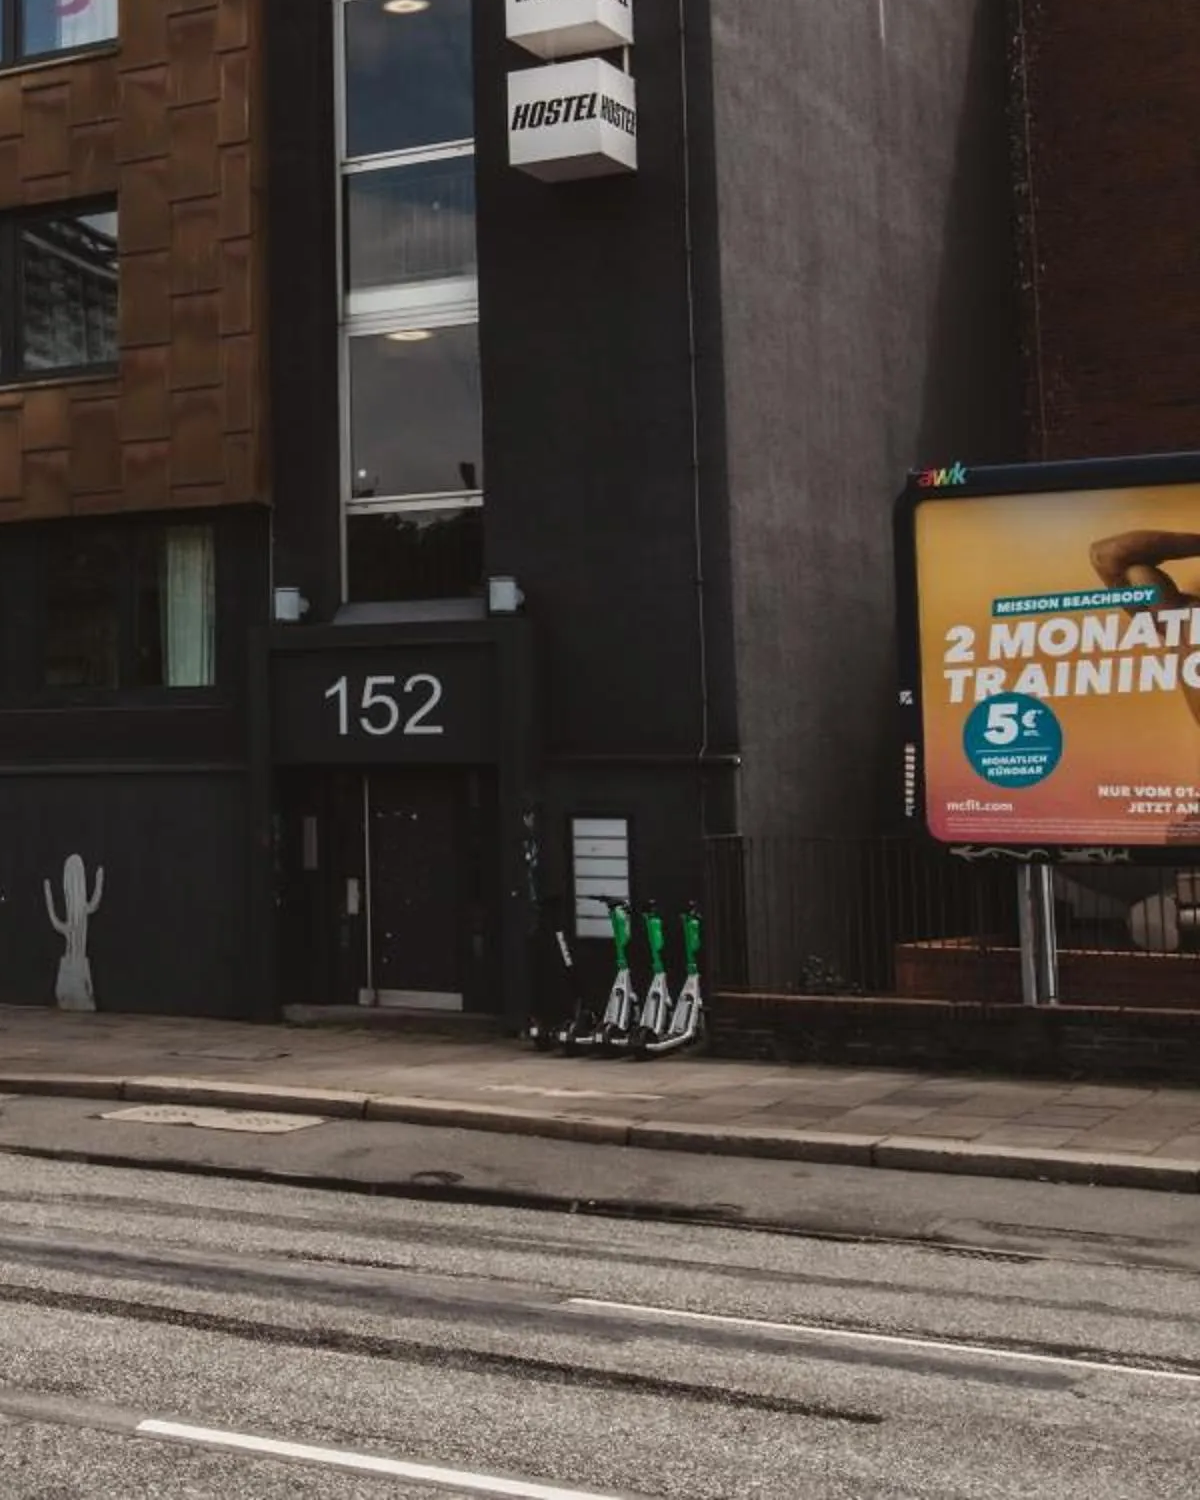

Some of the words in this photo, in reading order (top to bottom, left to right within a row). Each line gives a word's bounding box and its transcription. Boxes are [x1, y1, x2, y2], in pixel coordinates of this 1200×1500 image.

[511, 92, 598, 131] HOSTEL
[601, 94, 637, 136] HOSTEL
[917, 461, 967, 487] awk
[997, 599, 1059, 613] MISSION
[1063, 589, 1155, 608] BEACHBODY
[943, 625, 976, 663] 2
[324, 673, 444, 735] 152
[1098, 785, 1131, 797] NUR
[1135, 786, 1171, 797] VOM
[945, 799, 1014, 812] mcfit.com
[1128, 802, 1172, 813] JETZT
